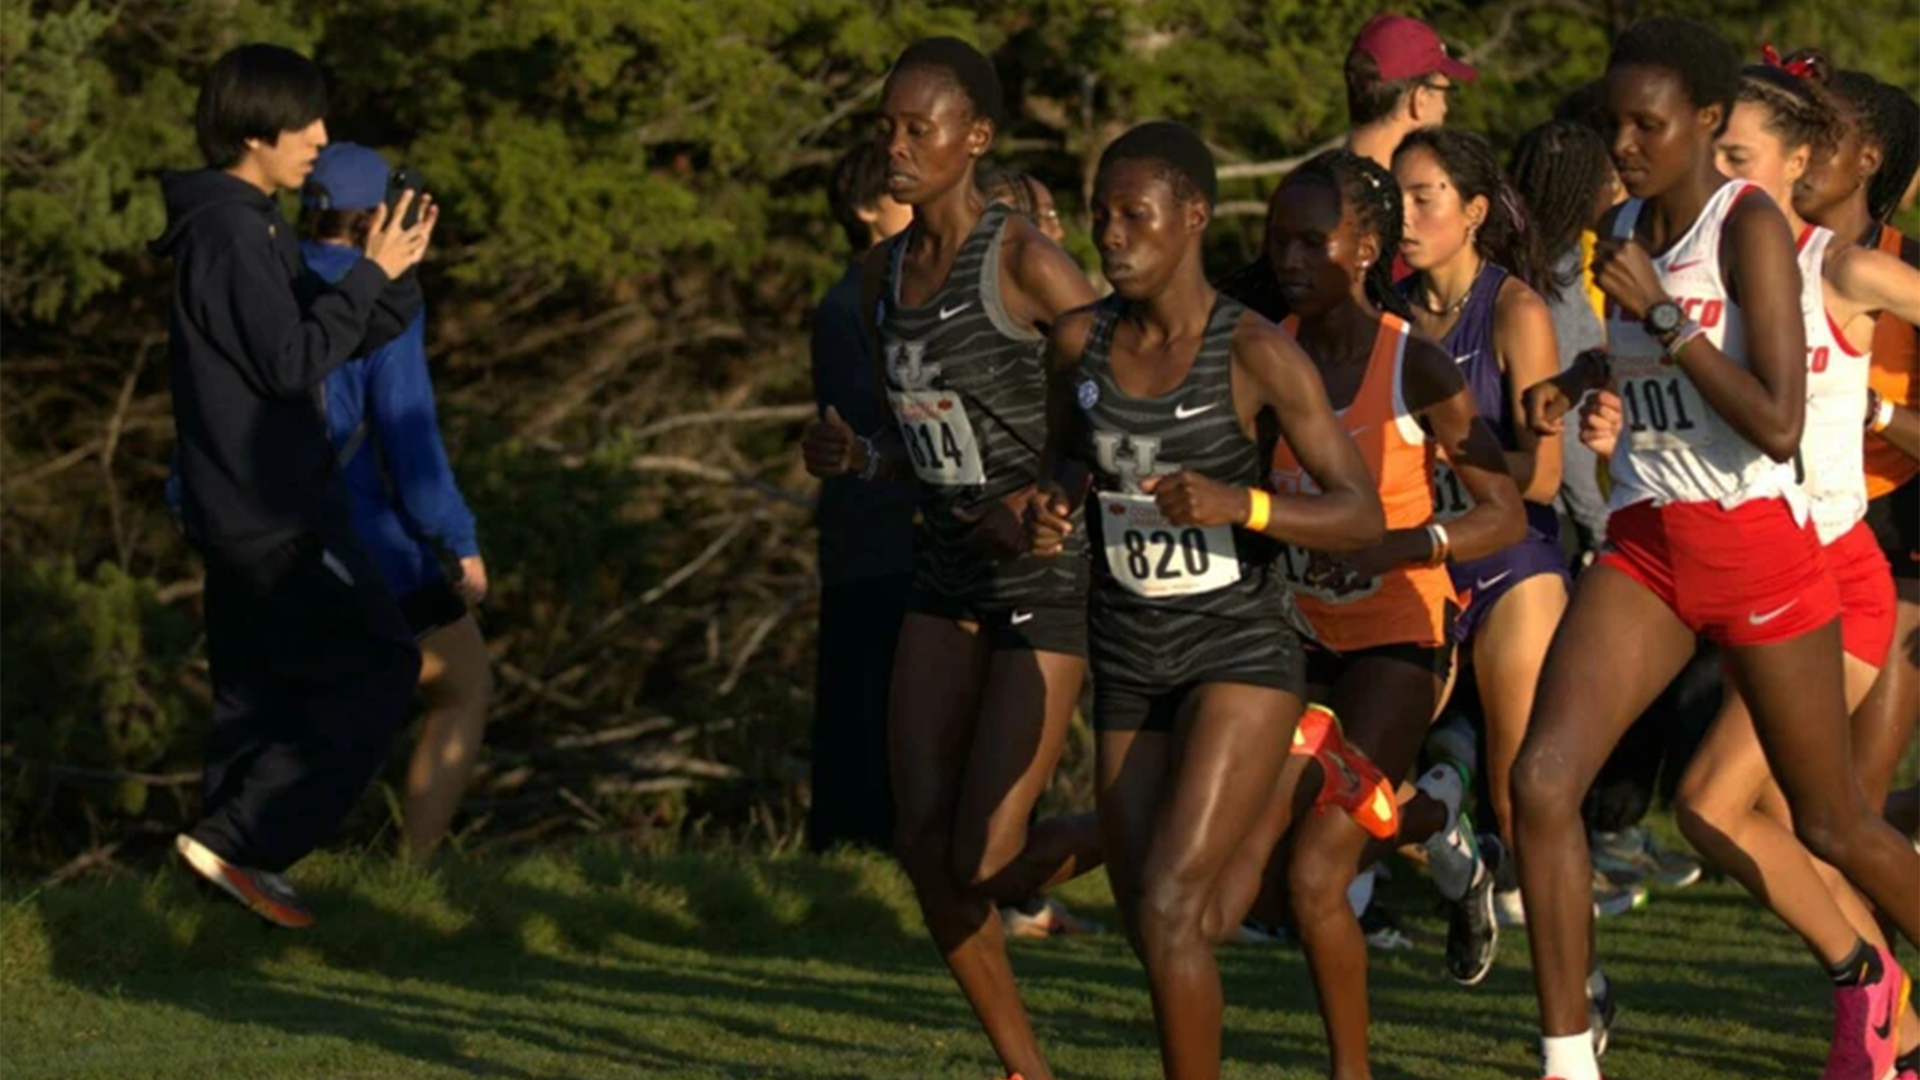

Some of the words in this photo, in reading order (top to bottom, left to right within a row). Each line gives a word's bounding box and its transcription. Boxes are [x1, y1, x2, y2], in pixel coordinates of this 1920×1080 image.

[1624, 378, 1695, 432] 101
[903, 422, 962, 468] 814
[1124, 527, 1210, 580] 820
